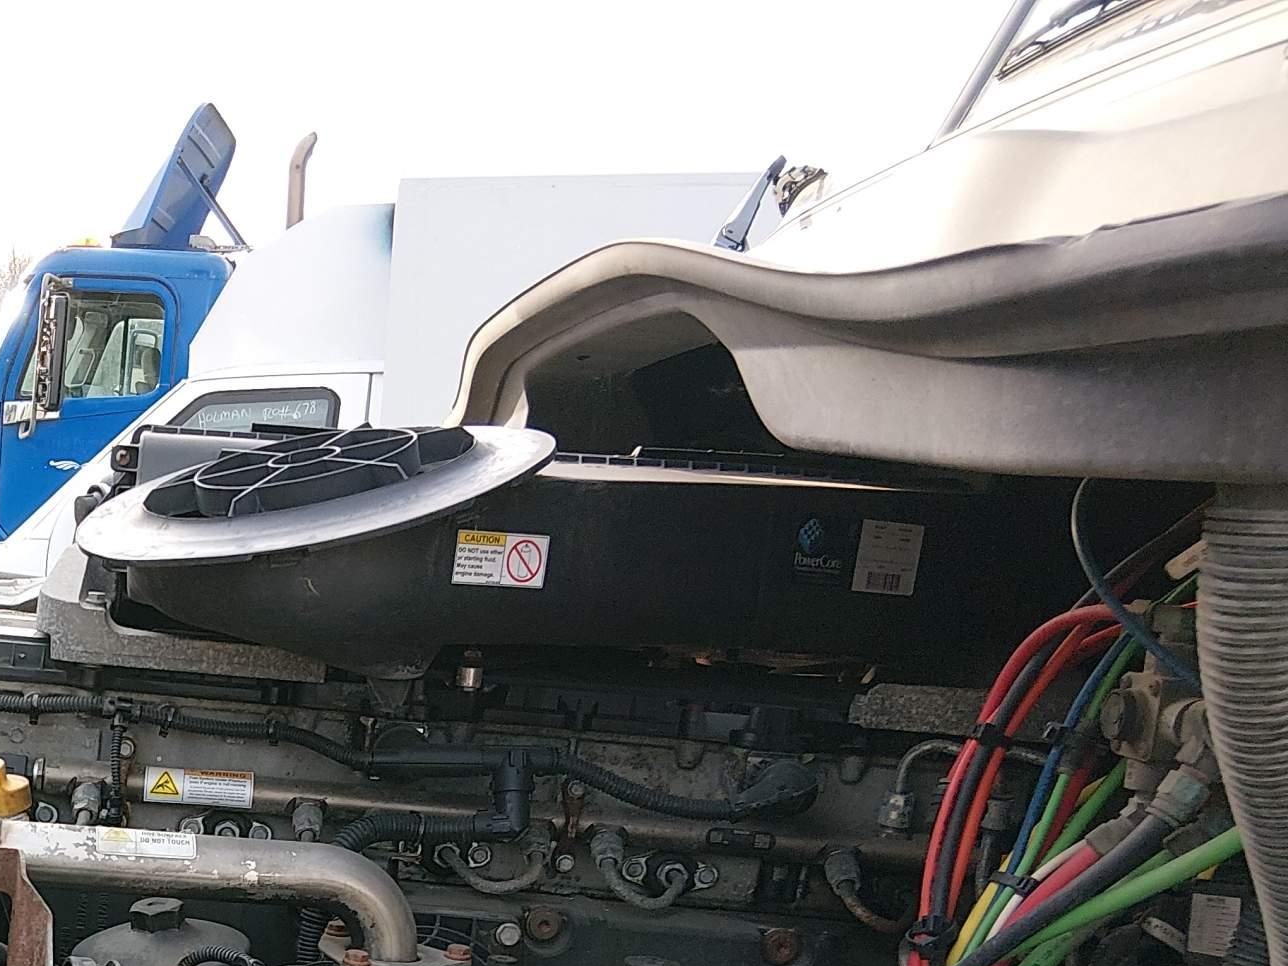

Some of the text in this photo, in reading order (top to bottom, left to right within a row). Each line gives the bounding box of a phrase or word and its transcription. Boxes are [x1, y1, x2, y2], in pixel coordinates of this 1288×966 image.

[198, 408, 252, 428] HOLMAN
[464, 534, 500, 544] CAUTION
[200, 771, 246, 779] WARNING
